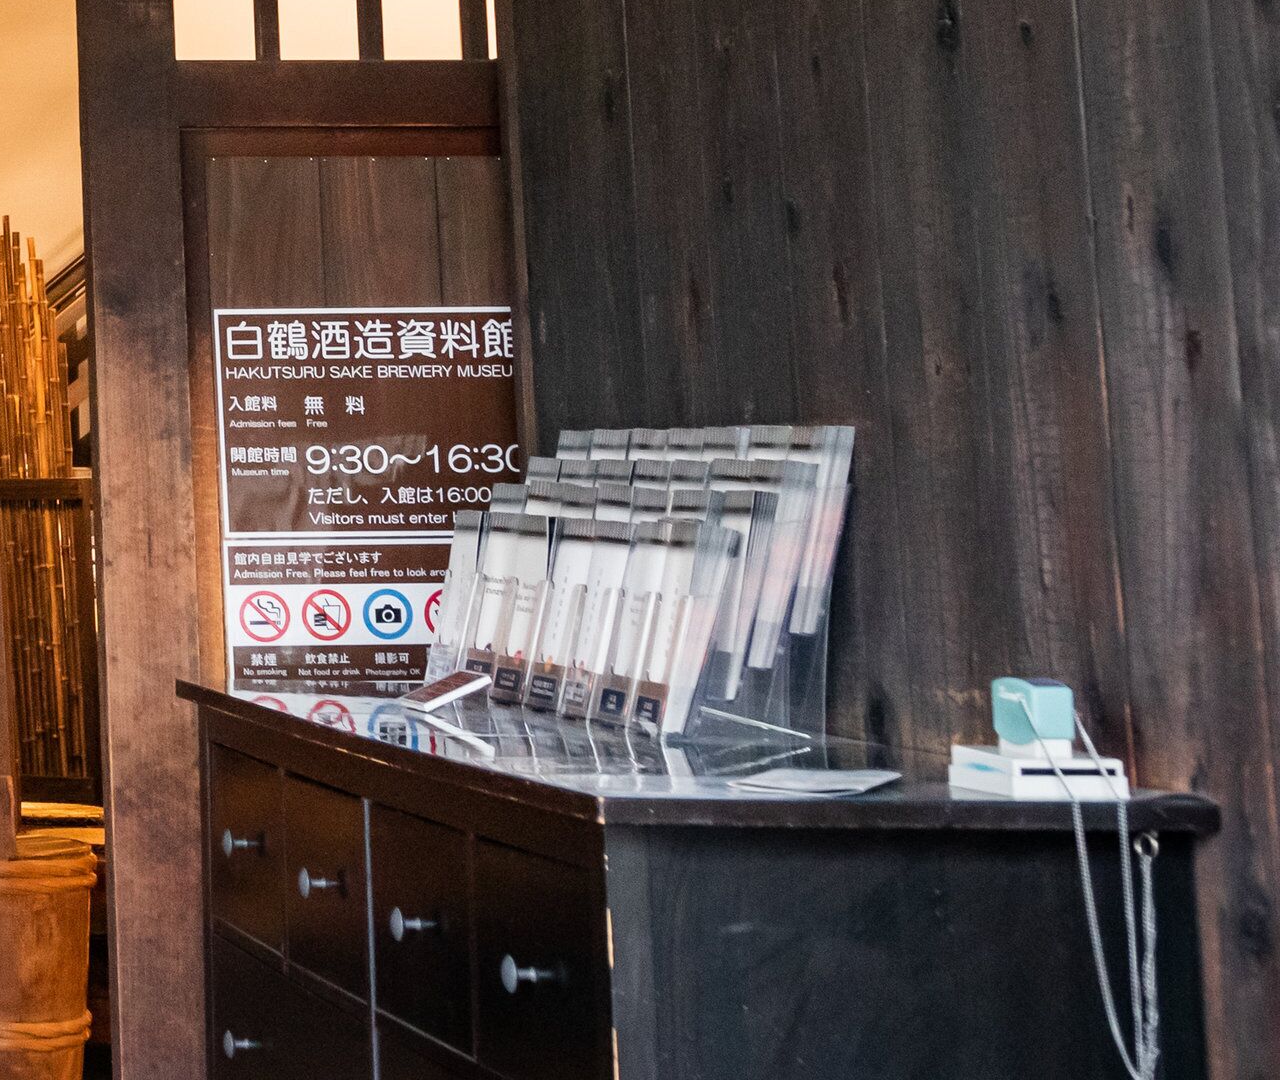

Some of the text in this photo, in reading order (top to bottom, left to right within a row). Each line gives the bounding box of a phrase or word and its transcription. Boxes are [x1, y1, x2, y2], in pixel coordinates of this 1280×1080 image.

[226, 318, 513, 361] 白鶴酒造資料館
[225, 366, 325, 380] HAKUTSURU
[329, 366, 373, 380] SAKE
[377, 365, 452, 379] BREWERY
[228, 395, 278, 412] 入館料
[229, 419, 328, 428] Admission fees Free
[230, 446, 297, 464] 開館時間
[231, 468, 290, 476] Museum time
[309, 512, 363, 525] Visitors
[368, 513, 405, 525] must
[409, 512, 448, 524] enter
[234, 568, 283, 579] Admission
[314, 568, 346, 578] Please
[349, 568, 368, 577] feel
[370, 568, 390, 577] free
[393, 568, 404, 577] to
[406, 567, 427, 577] look
[251, 653, 277, 666] 禁煙
[304, 652, 350, 665] 飲食禁止
[243, 667, 288, 677] No smoking
[298, 668, 312, 676] Not
[313, 668, 331, 676] food
[342, 668, 361, 676] drink
[365, 668, 421, 677] Photography OK
